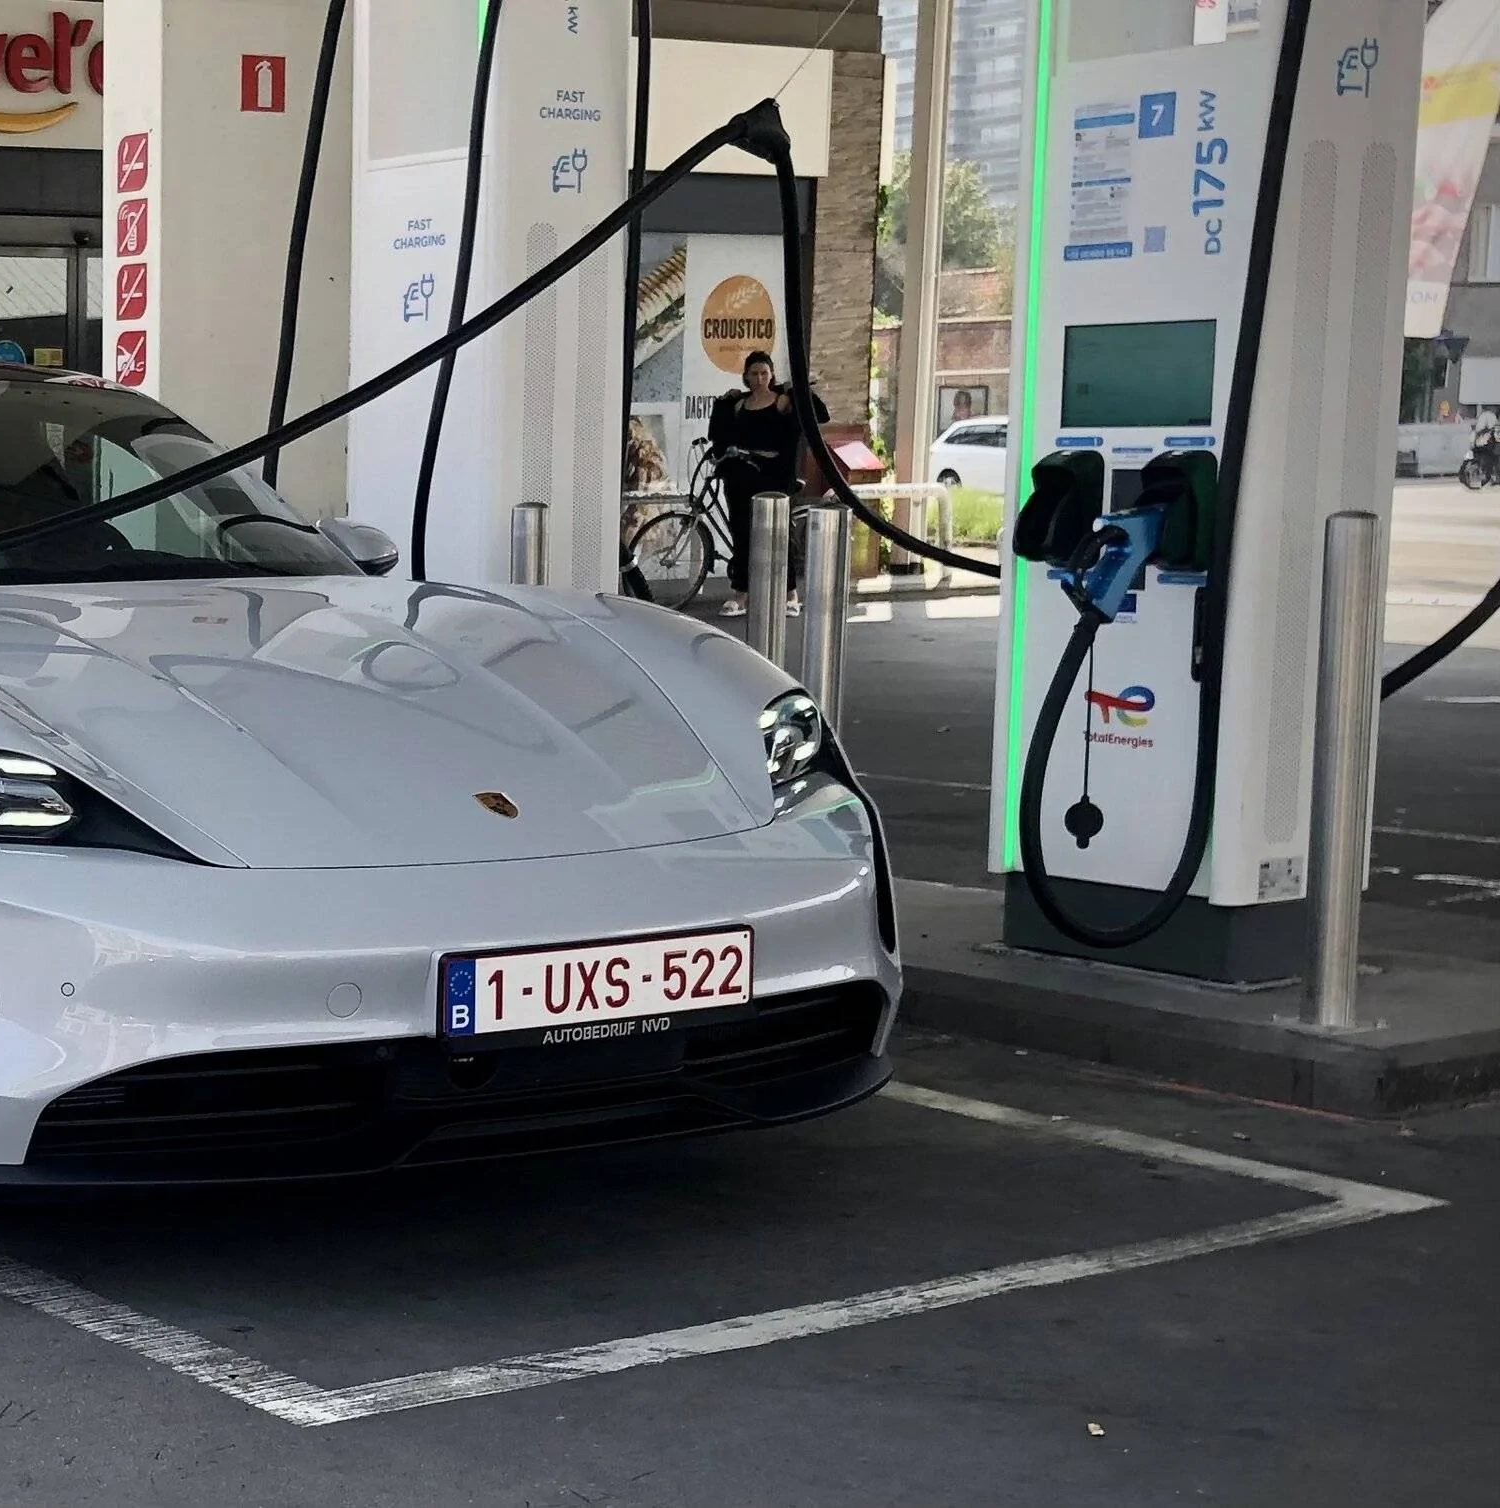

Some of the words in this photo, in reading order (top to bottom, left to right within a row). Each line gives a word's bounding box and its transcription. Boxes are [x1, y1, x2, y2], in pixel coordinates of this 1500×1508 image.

[556, 89, 585, 103] FAST
[539, 106, 601, 122] CHARGING
[1151, 103, 1165, 127] 7
[1197, 90, 1217, 131] kW
[1192, 138, 1229, 217] 175
[407, 218, 432, 231] FAST
[1204, 218, 1223, 255] DC
[393, 234, 446, 250] CHARGING
[703, 318, 773, 340] CROUSTICO
[486, 944, 744, 1021] 1-UXS-522
[451, 1004, 470, 1030] B
[542, 1021, 636, 1046] AUTOBEDRIJF
[641, 1016, 671, 1033] NVD
